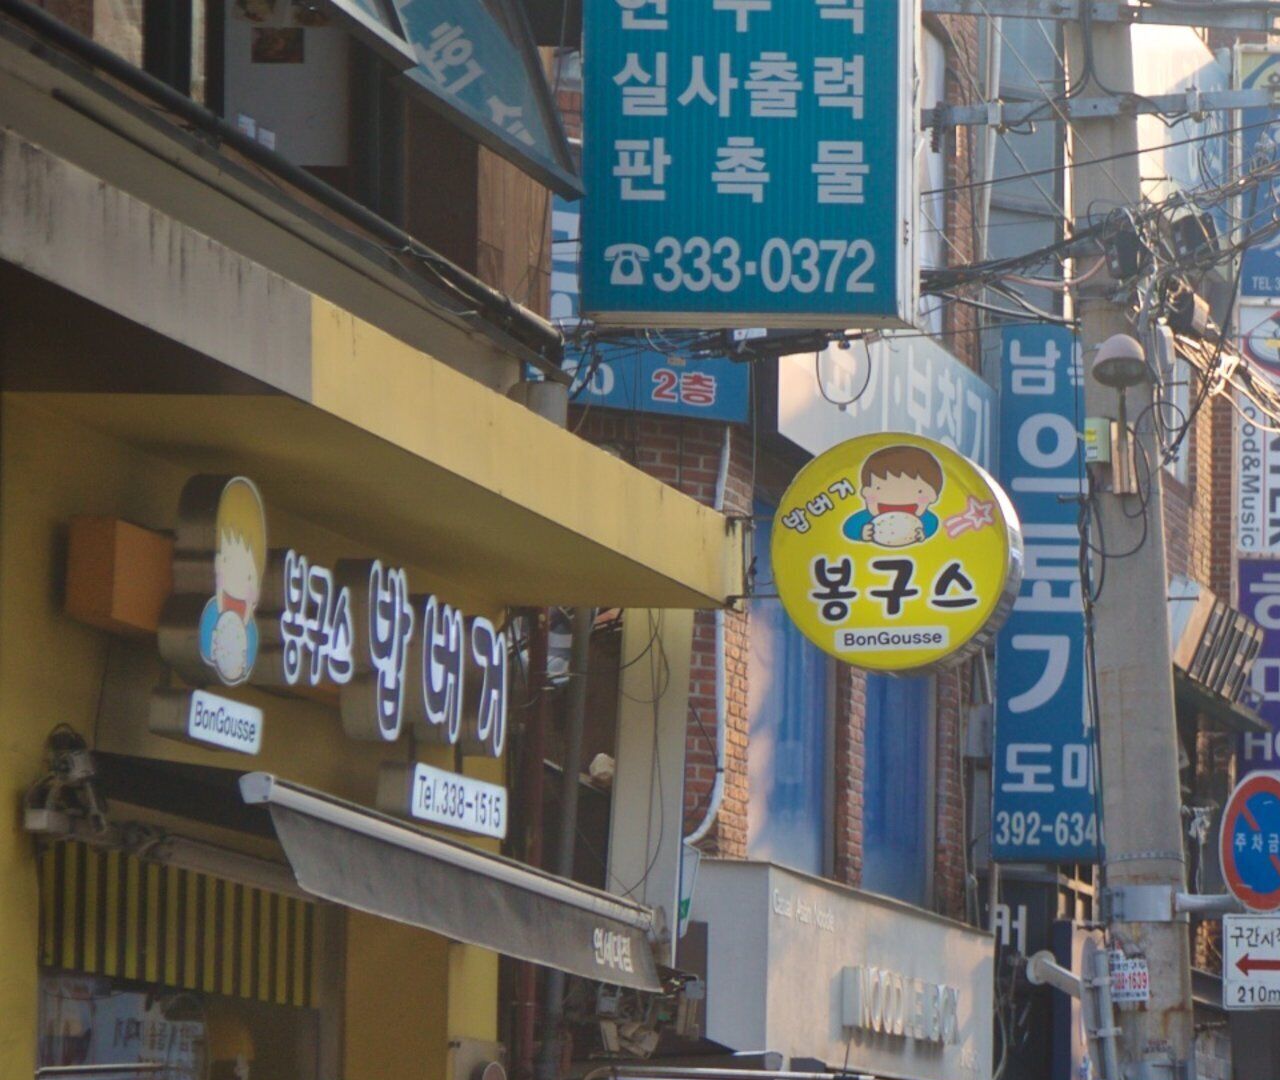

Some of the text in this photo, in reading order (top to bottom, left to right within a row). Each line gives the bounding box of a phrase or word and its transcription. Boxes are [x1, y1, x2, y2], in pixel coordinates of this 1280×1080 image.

[612, 52, 865, 119] 실사출력
[612, 137, 870, 203] 판촉물
[652, 369, 716, 405] 2층
[812, 557, 978, 622] 봉구스
[281, 549, 507, 758] 봉구스 밥버거
[844, 630, 942, 647] BonGousse
[193, 700, 257, 745] BonGousse
